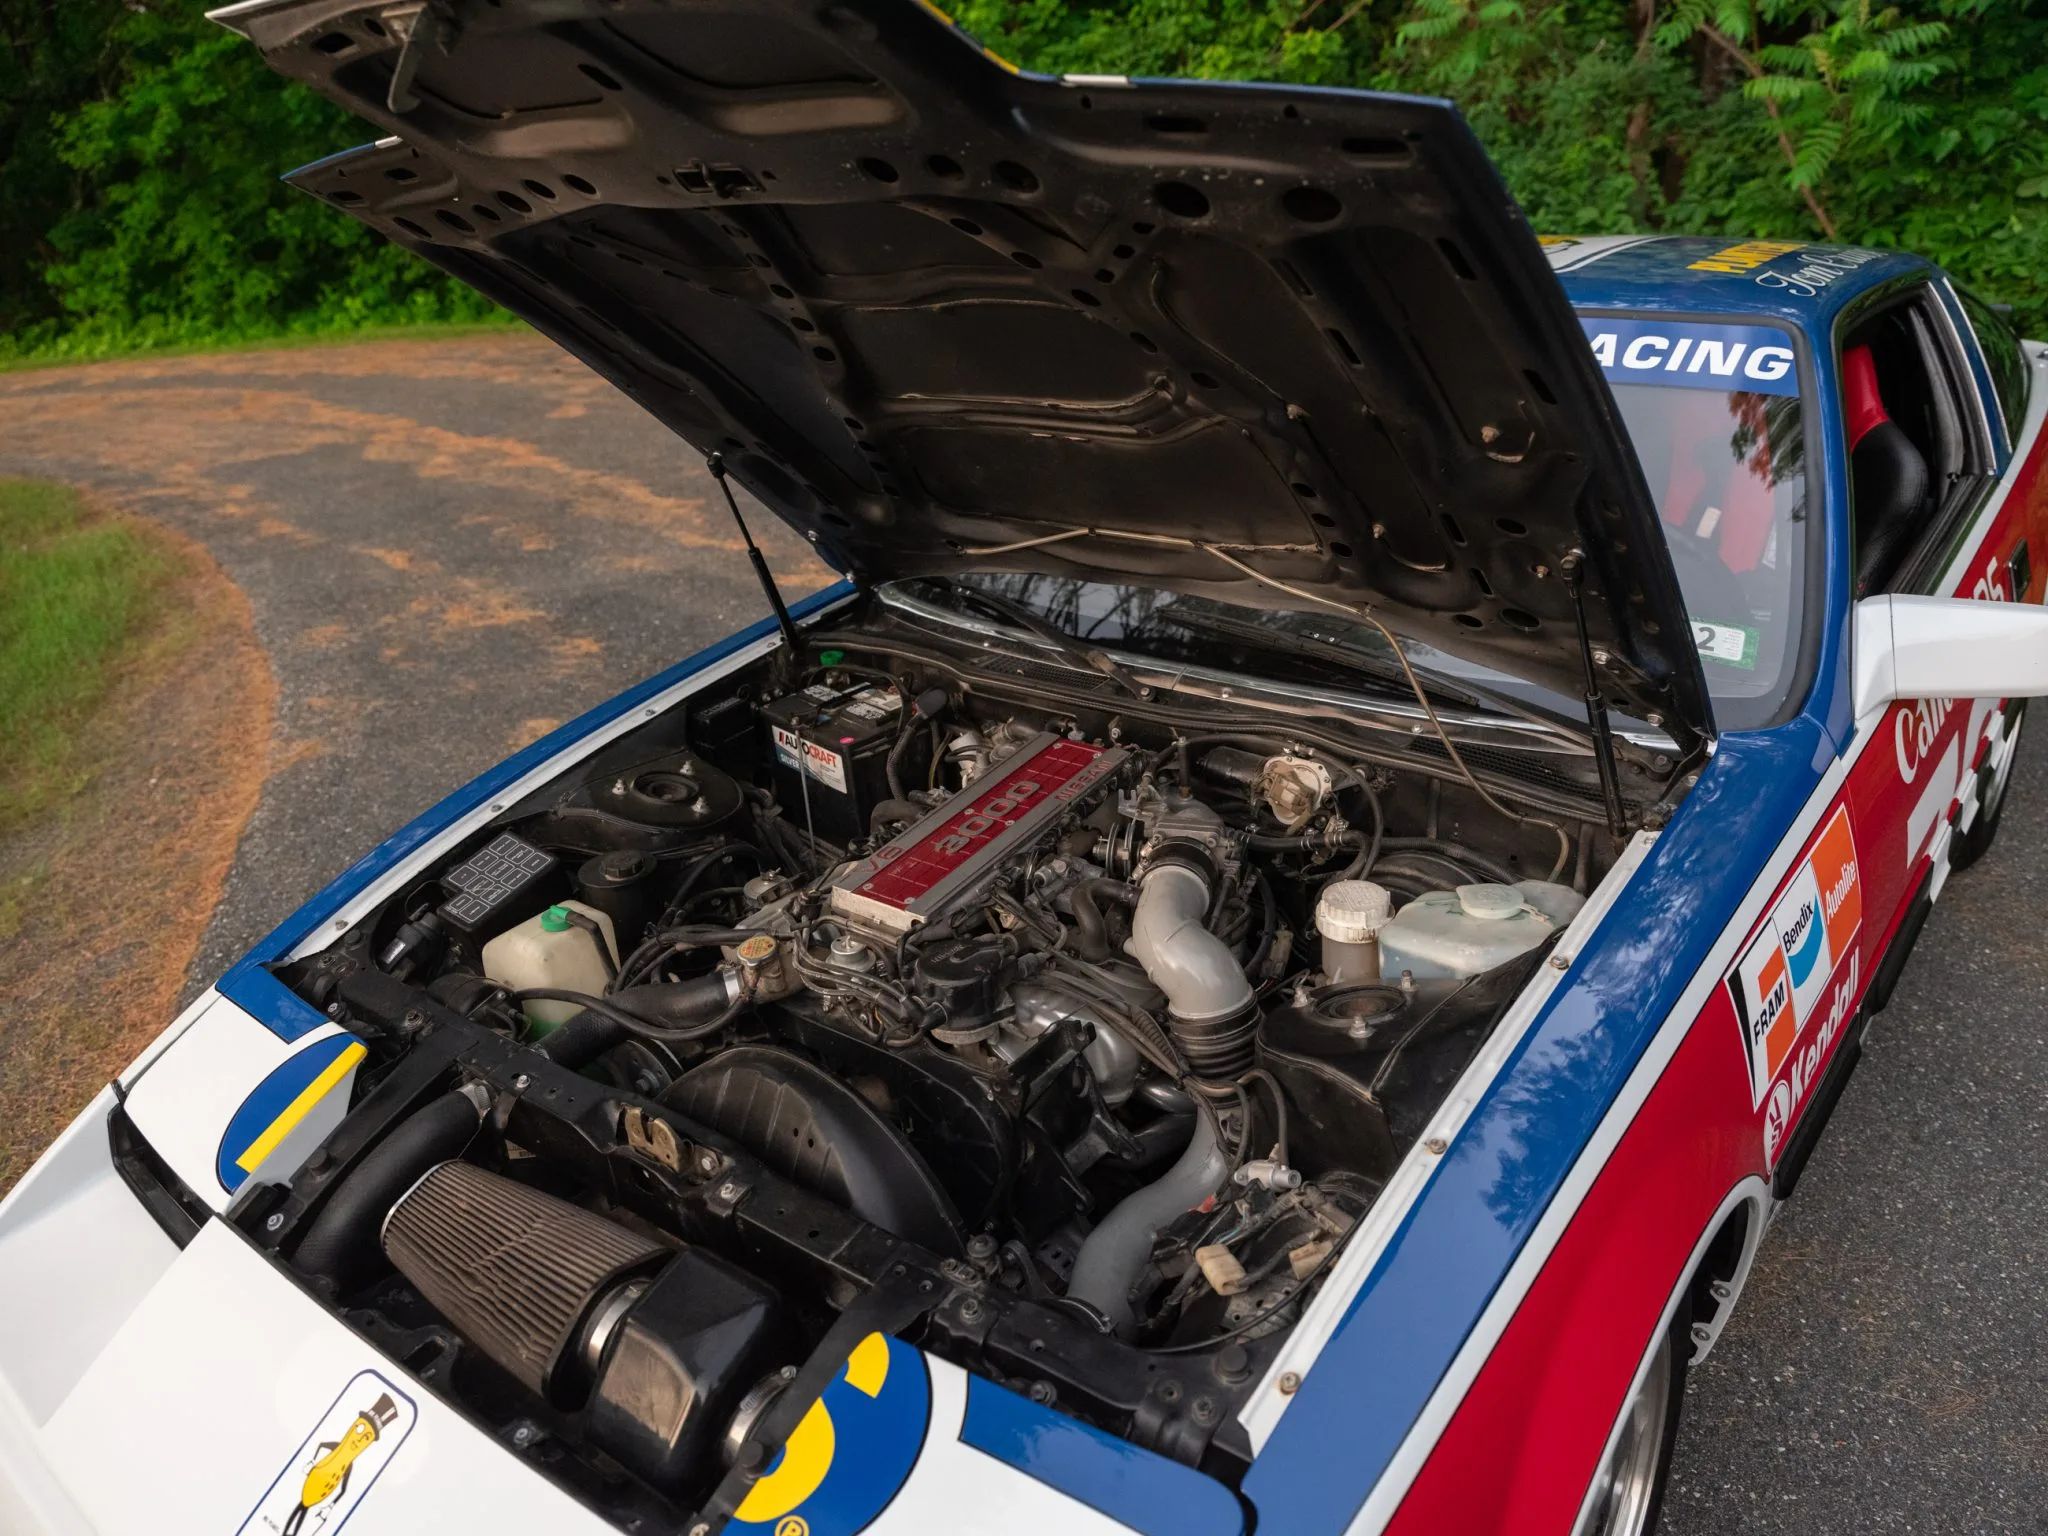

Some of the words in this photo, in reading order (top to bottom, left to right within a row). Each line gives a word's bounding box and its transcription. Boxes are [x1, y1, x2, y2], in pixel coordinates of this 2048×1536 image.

[1755, 264, 1844, 297] Tom
[1697, 626, 1716, 652] 2
[784, 735, 837, 767] AUOCRAFT
[933, 780, 1041, 856] 3000
[1825, 860, 1857, 925] Autolite
[1782, 901, 1814, 954] Bendix
[1753, 981, 1785, 1046] FRAM
[1790, 945, 1860, 1117] Kendall
